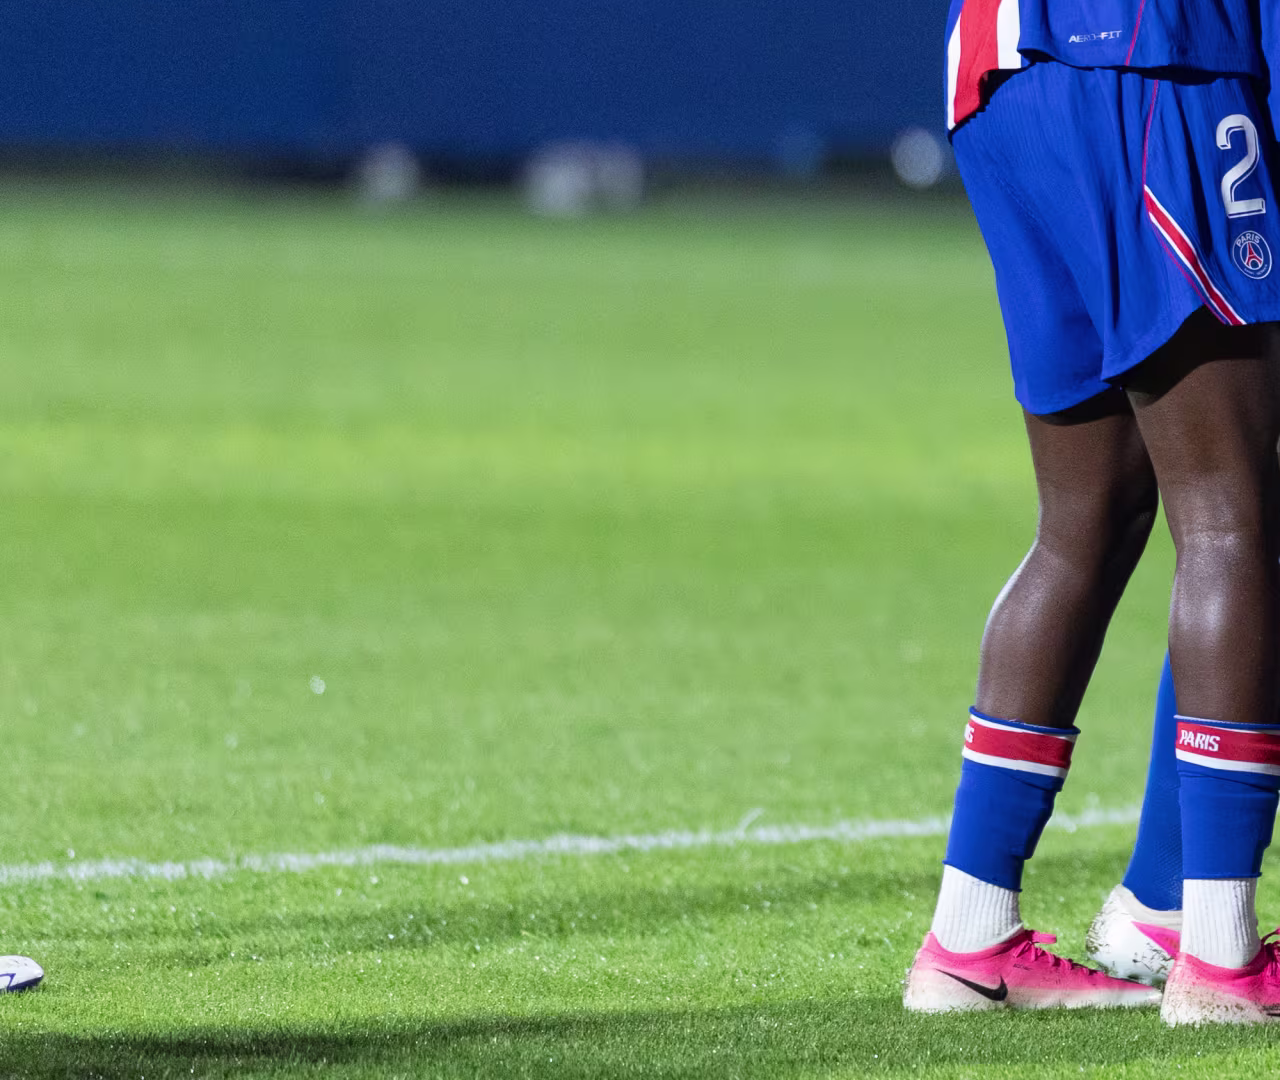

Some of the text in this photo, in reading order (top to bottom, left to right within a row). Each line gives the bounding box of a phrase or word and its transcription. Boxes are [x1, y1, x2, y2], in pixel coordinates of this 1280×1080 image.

[1216, 114, 1266, 218] 2
[1235, 232, 1261, 247] PARIS
[1179, 729, 1221, 752] PARIS
